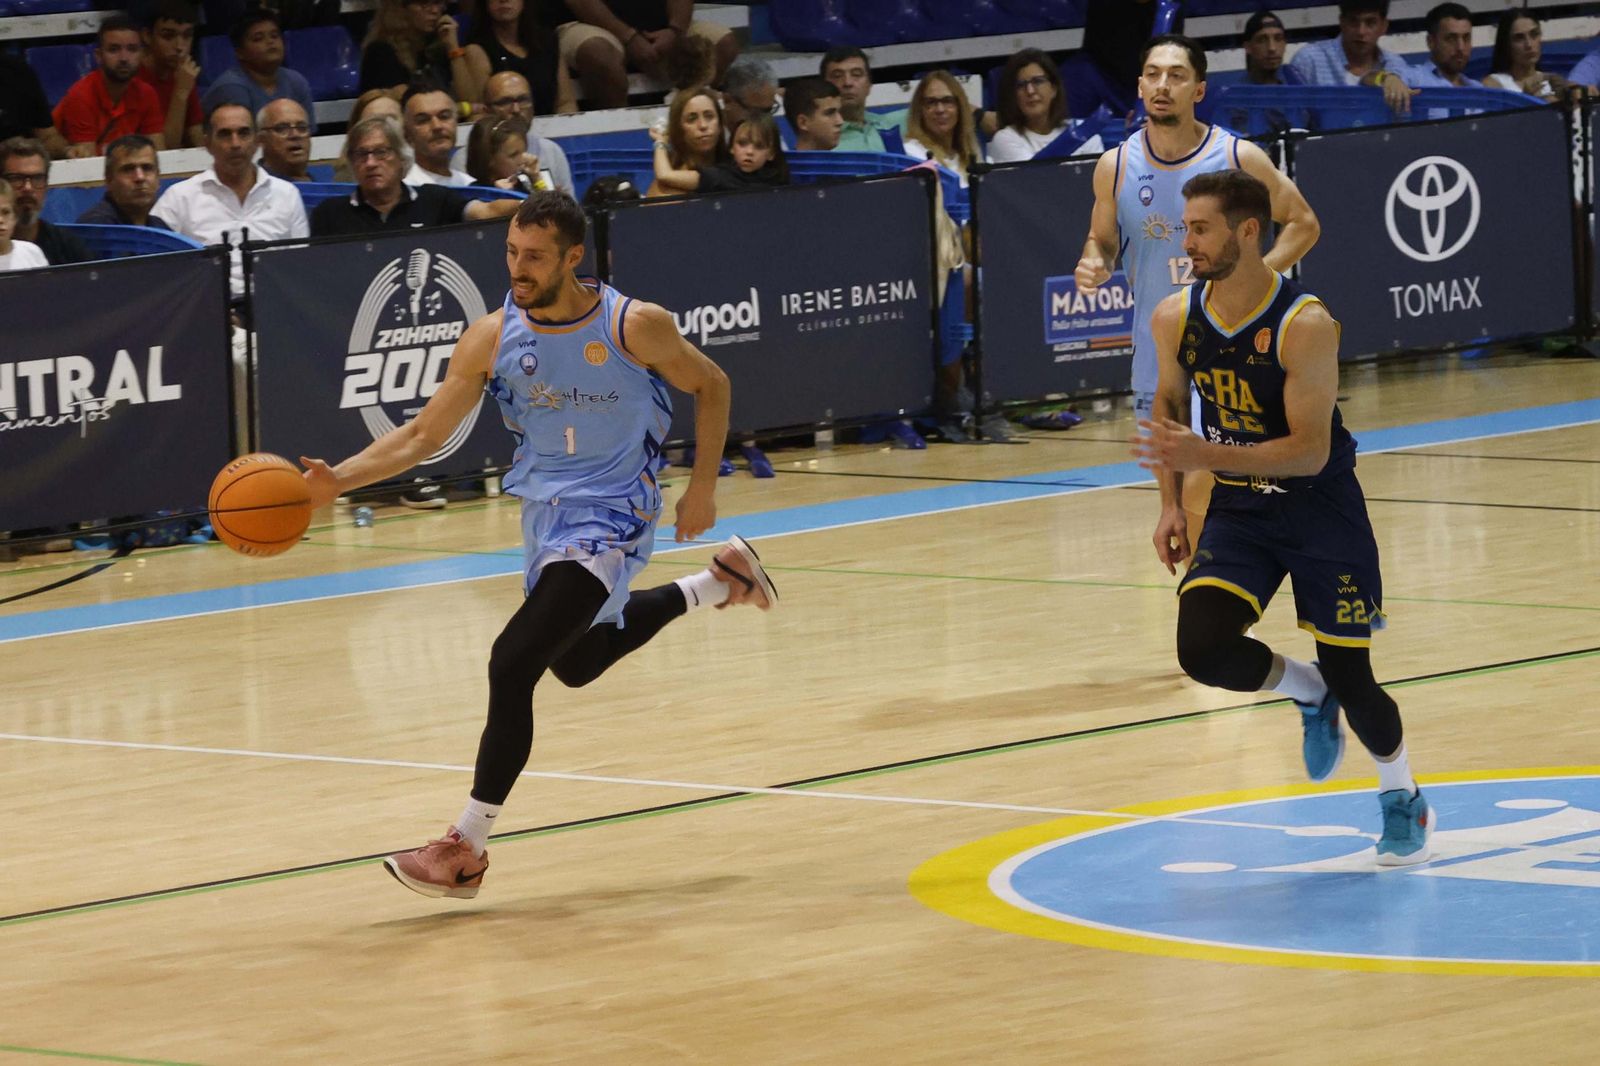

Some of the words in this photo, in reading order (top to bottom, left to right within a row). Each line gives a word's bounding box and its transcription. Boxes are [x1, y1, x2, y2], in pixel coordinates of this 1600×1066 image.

[1168, 256, 1196, 285] 12
[781, 287, 843, 316] IRENE
[851, 278, 918, 308] BAENA
[1389, 276, 1483, 319] TOMAX
[858, 311, 905, 325] DENTAL
[375, 320, 465, 349] ZAHARA
[563, 425, 577, 456] 1
[1336, 599, 1370, 624] 22
